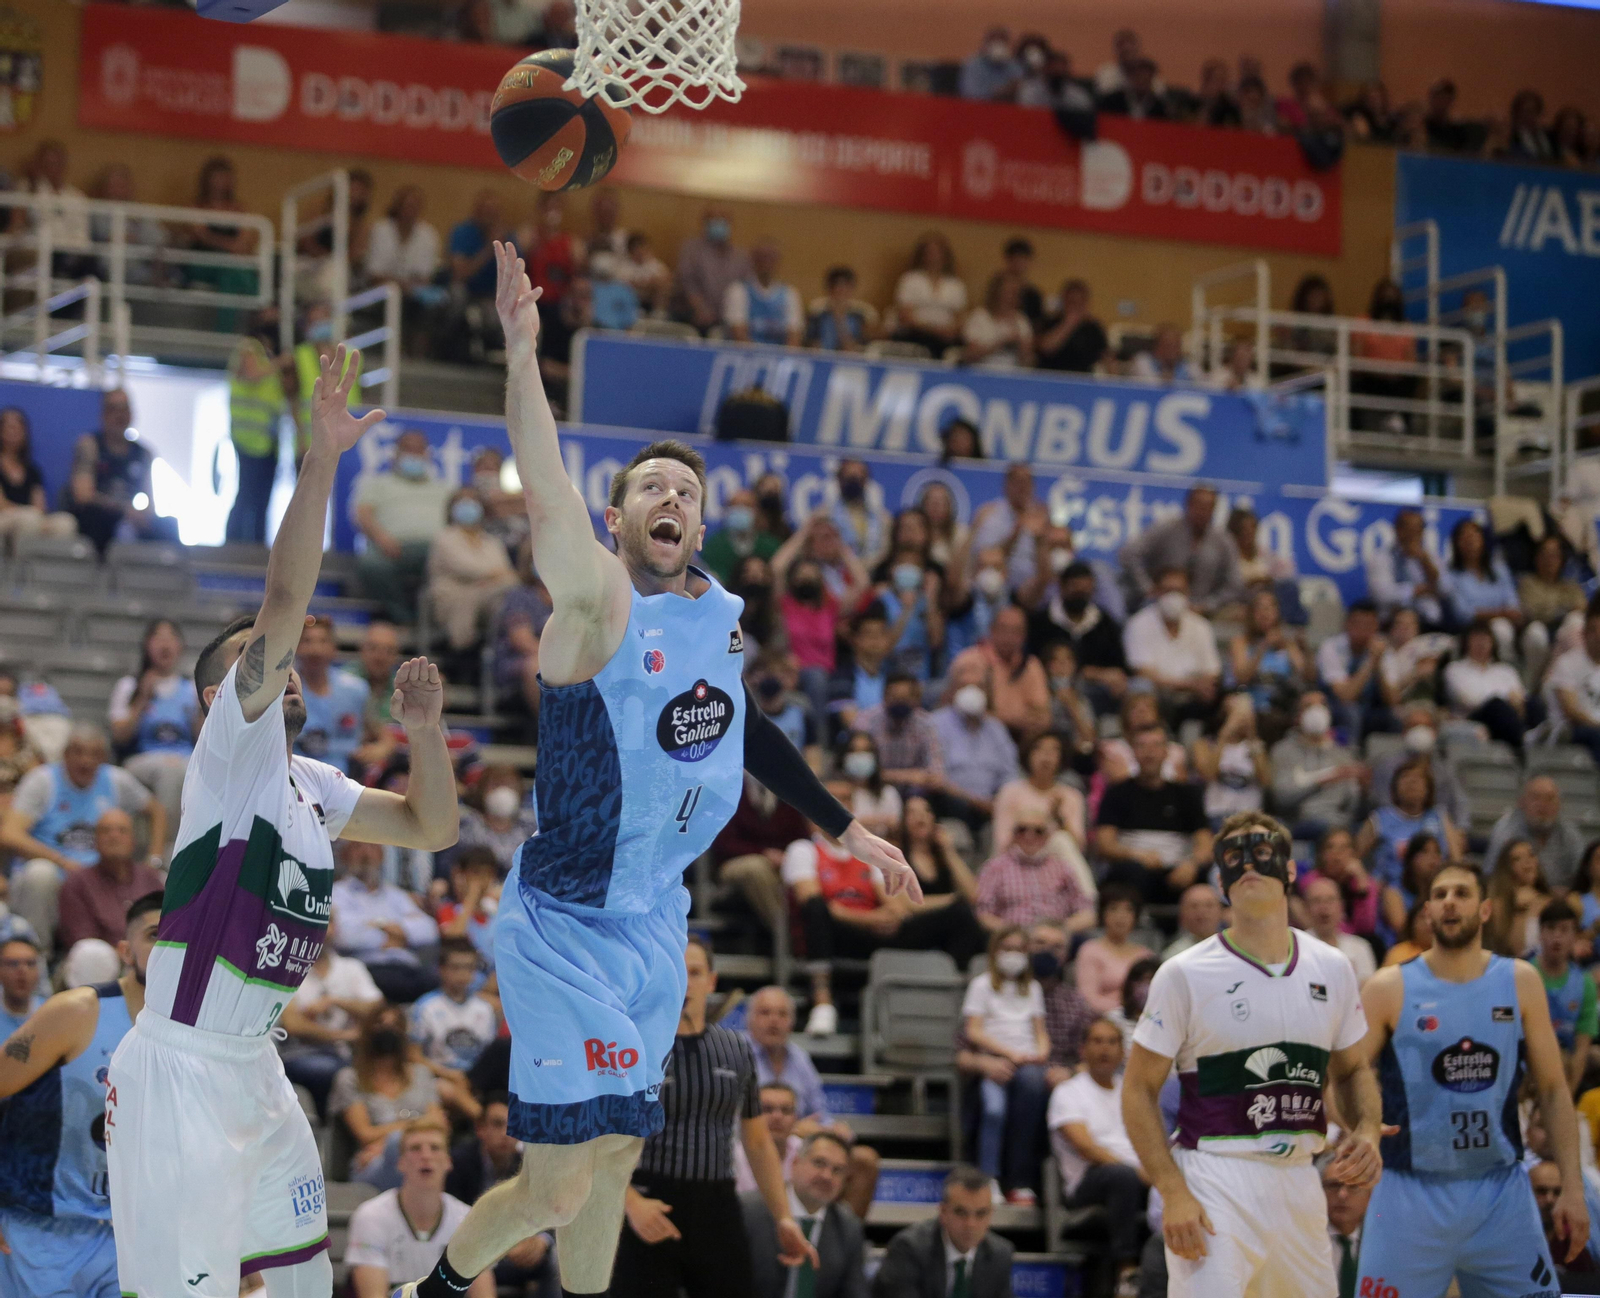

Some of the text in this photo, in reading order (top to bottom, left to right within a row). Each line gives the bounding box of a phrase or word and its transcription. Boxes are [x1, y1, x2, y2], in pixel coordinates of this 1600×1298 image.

[671, 700, 725, 726] Estrella
[674, 719, 721, 745] Galicia
[584, 1037, 639, 1072] Río
[1443, 1051, 1493, 1069] Estrella
[1445, 1064, 1492, 1082] Galicia
[1450, 1109, 1491, 1150] 33
